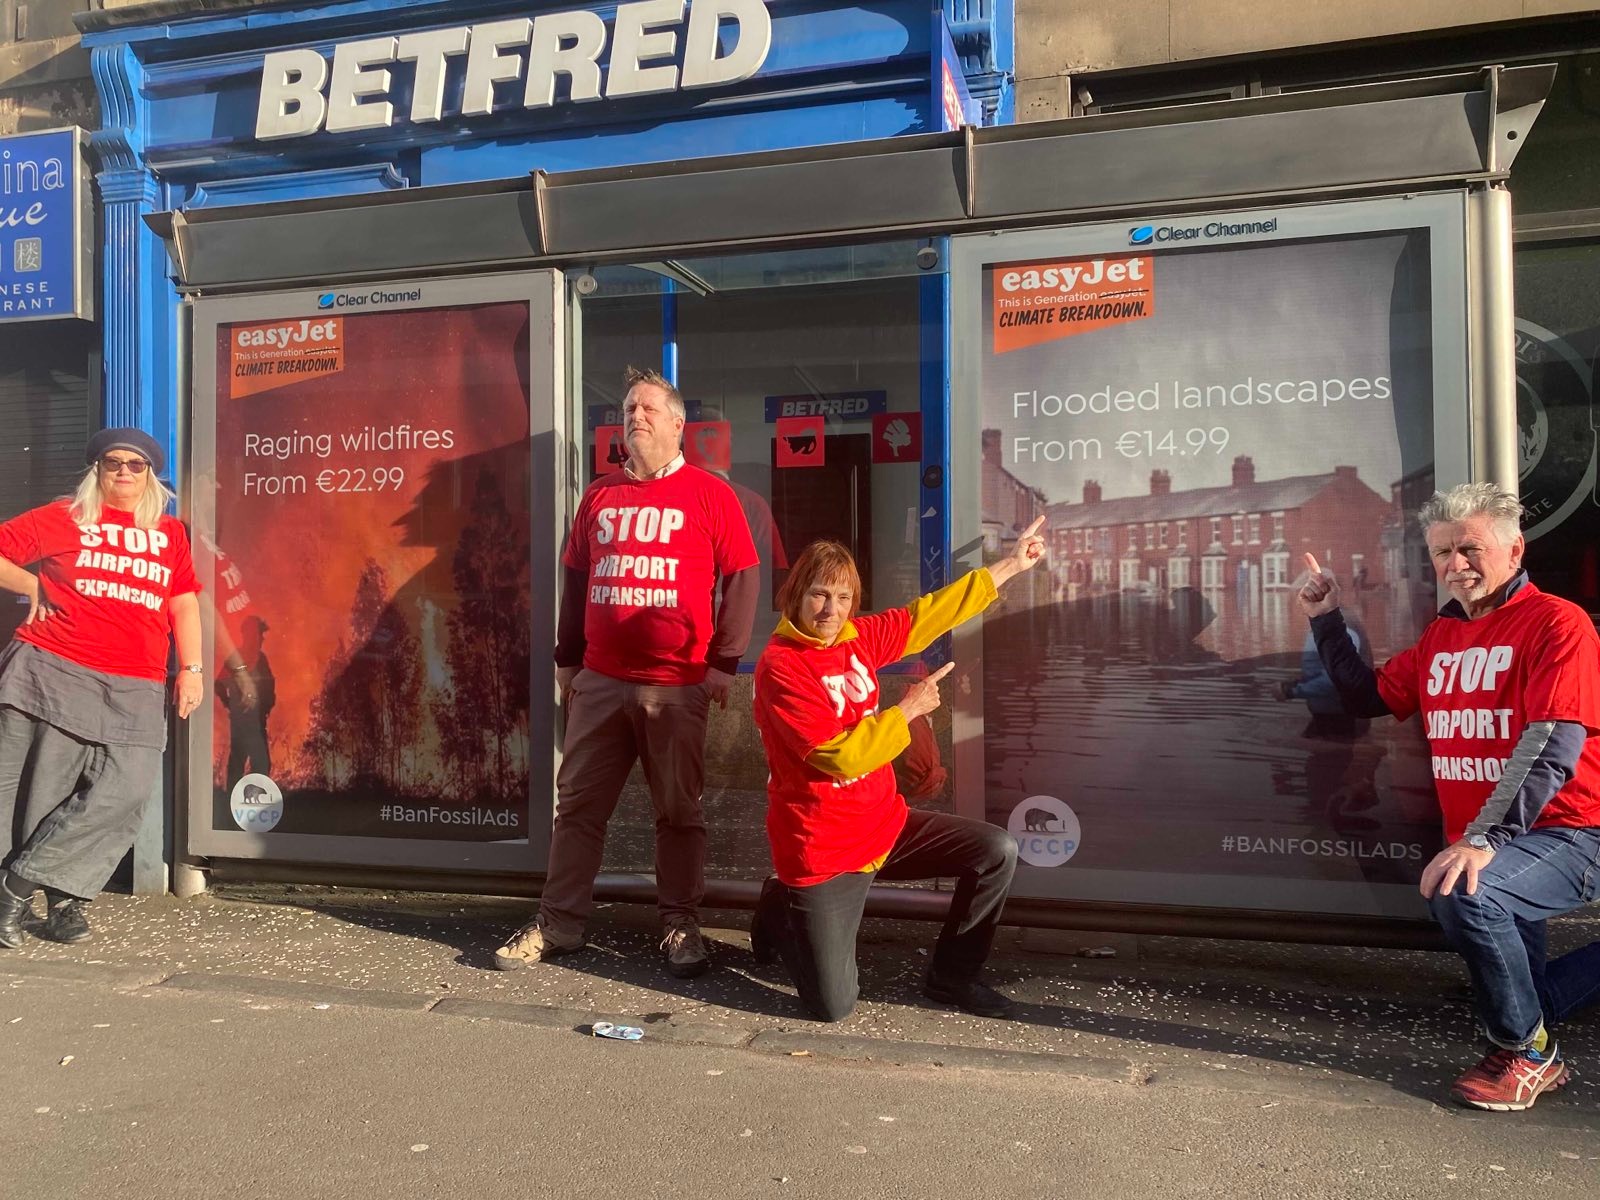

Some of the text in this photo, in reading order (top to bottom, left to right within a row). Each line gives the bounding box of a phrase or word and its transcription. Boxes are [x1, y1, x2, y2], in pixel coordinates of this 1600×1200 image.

[255, 0, 772, 141] BETFRED
[1155, 217, 1278, 242] Clear Channel
[1001, 257, 1145, 293] easyJet
[336, 287, 421, 307] Clear Channel
[998, 298, 1021, 308] This
[1023, 297, 1032, 306] is
[1034, 292, 1098, 305] Generation
[999, 301, 1147, 328] CLIMATE BREAKDOWN.
[238, 320, 337, 349] easyJet
[235, 350, 251, 361] This
[252, 350, 259, 360] is
[260, 348, 304, 359] Generation
[235, 357, 339, 378] CLIMATE BREAKDOWN.
[781, 398, 869, 417] BETFRED
[1013, 374, 1392, 419] Flooded landscapes
[245, 425, 455, 460] Raging wildfires
[1013, 427, 1230, 463] From €14.99
[244, 467, 405, 496] From €22.99
[597, 506, 684, 545] STOP
[78, 523, 169, 557] STOP
[75, 549, 172, 588] AIRPORT
[594, 554, 680, 582] AIRPORT
[75, 579, 164, 612] EXPANSION
[591, 585, 678, 608] EXPANSION
[1427, 645, 1514, 697] STOP
[234, 807, 280, 825] VCCP
[379, 804, 519, 827] #BanFossilAds
[1221, 836, 1423, 860] #BANFOSSILADS
